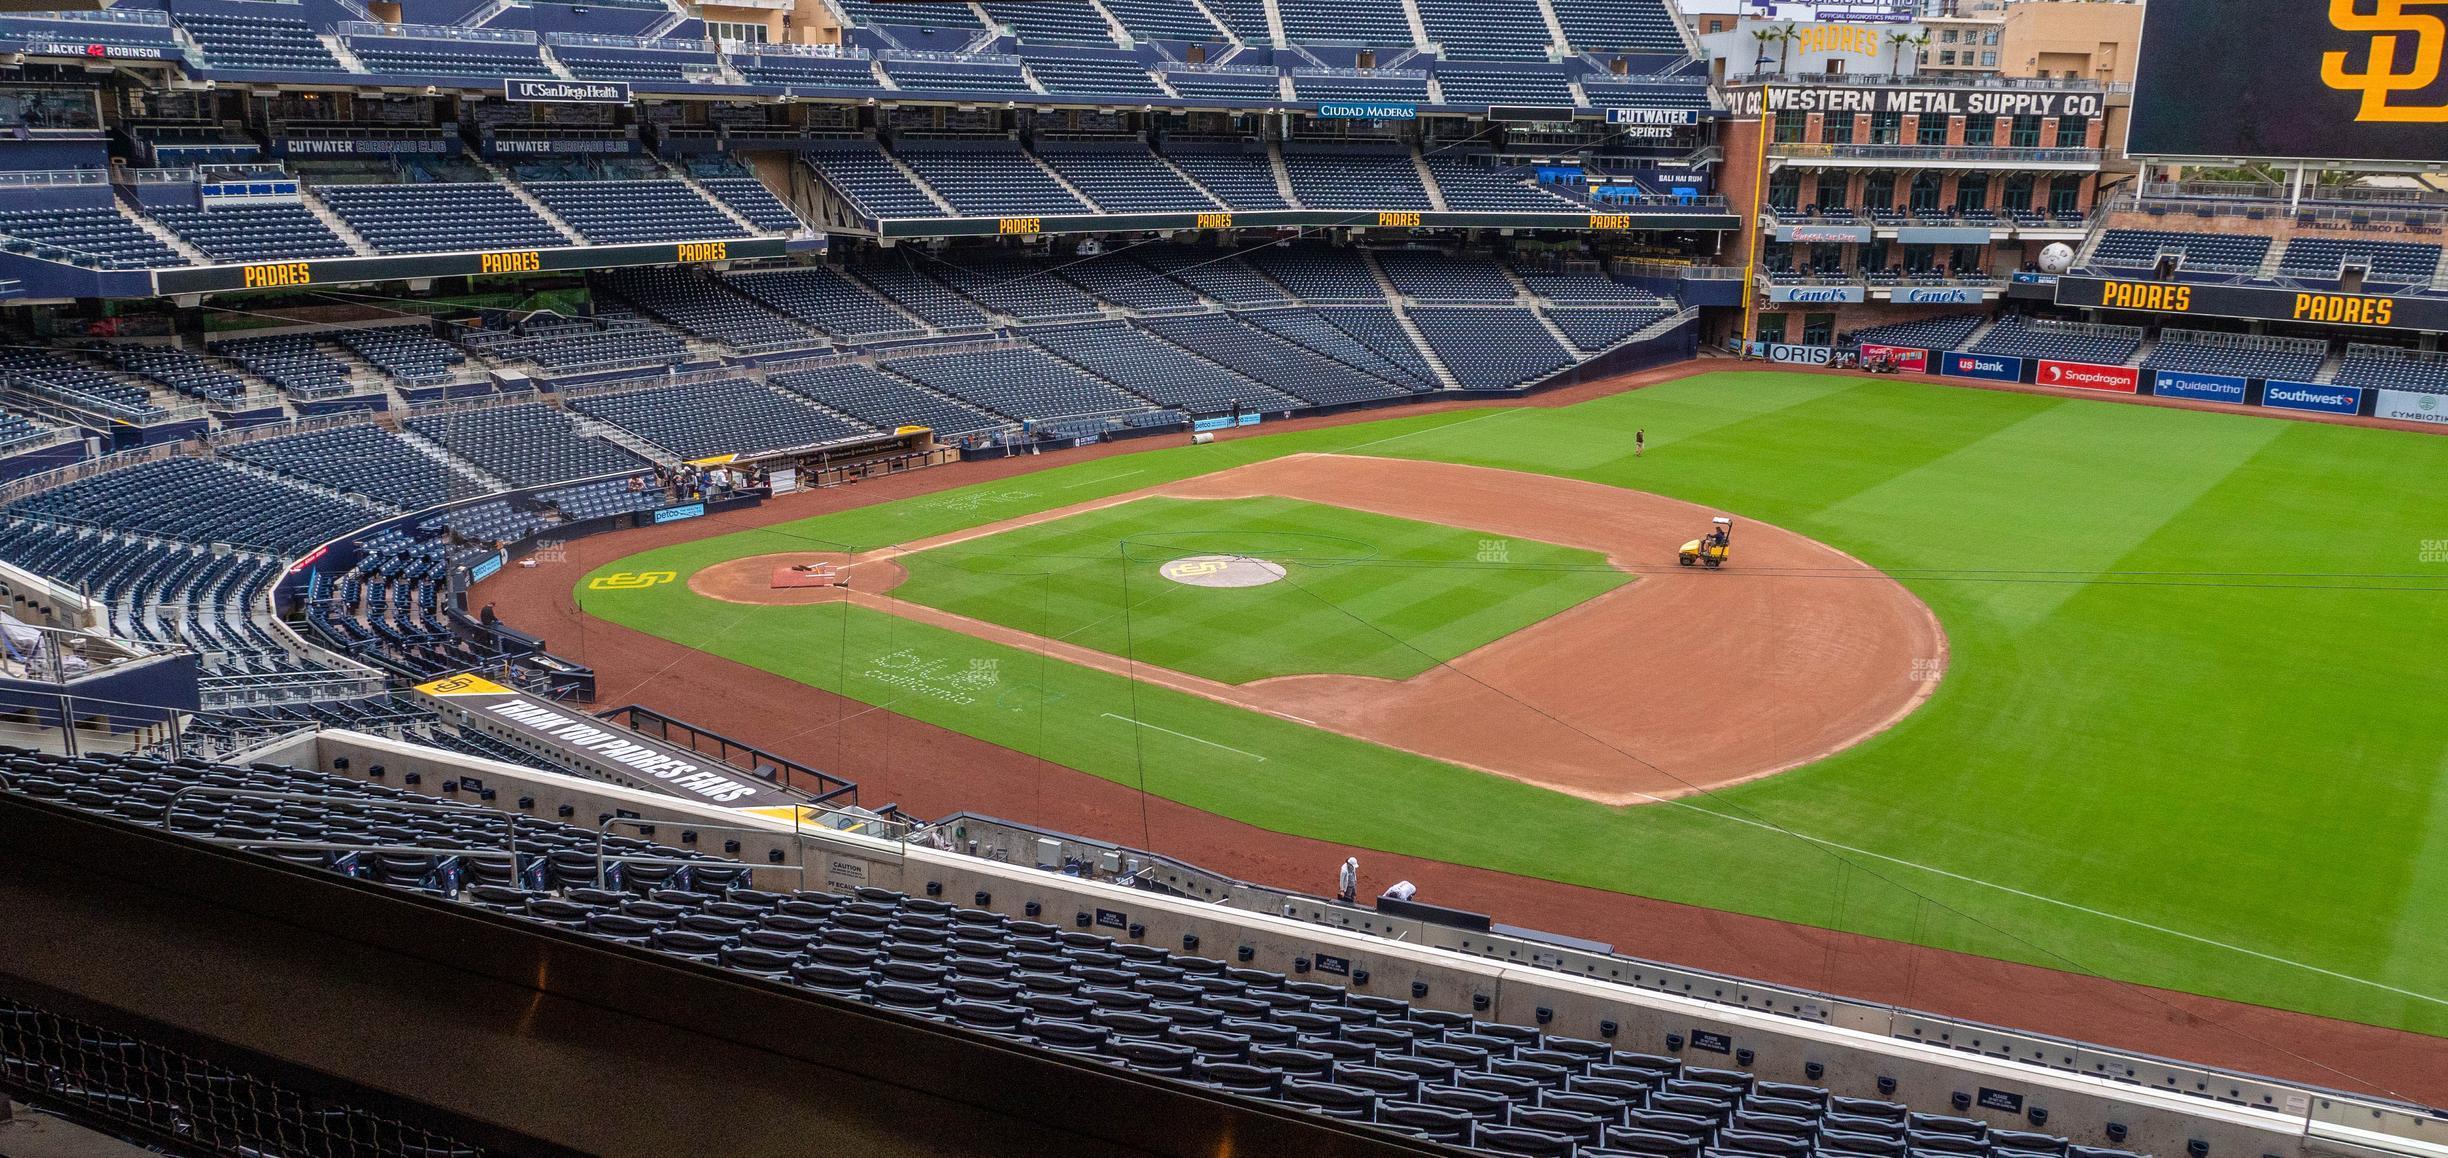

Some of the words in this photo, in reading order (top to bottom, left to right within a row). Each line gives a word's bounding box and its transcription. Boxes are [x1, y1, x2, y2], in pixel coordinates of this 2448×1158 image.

[1820, 12, 1845, 20] OFFICIAL
[1846, 13, 1884, 21] DIAGNOSTICS
[1799, 25, 1878, 57] PADRES
[46, 44, 85, 55] JACKIE
[87, 44, 105, 57] 42
[107, 46, 161, 58] ROBINSON
[520, 83, 538, 96] UC
[538, 83, 558, 97] San
[558, 85, 587, 100] Diego
[587, 85, 619, 98] Health
[1767, 88, 1875, 111] WESTERN
[1886, 91, 1960, 113] METAL
[1968, 92, 2057, 115] SUPPLY
[2064, 95, 2101, 116] CO.
[1321, 105, 1364, 116] CIUDAD
[1366, 106, 1415, 118] MADERAS
[1617, 109, 1688, 124] CUTWATER
[1629, 126, 1673, 138] SPIRITS
[288, 140, 353, 152] CUTWATER
[356, 140, 418, 153] CORONADO
[418, 140, 447, 153] CLUB
[496, 140, 550, 152] CUTWATER
[552, 140, 604, 153] CORONADO
[604, 140, 629, 153] CLUB
[1658, 174, 1675, 182] BALI
[1675, 175, 1687, 183] HAI
[1687, 175, 1703, 183] RUM
[1000, 218, 1040, 234] PADRES
[1197, 213, 1232, 229] PADRES
[1379, 212, 1421, 227] PADRES
[1590, 214, 1630, 229] PADRES
[2296, 221, 2347, 231] ESTRELLA
[2349, 223, 2392, 233] JALISCO
[2394, 225, 2443, 236] LANDING
[677, 242, 726, 262] PADRES
[482, 251, 540, 273] PADRES
[244, 262, 310, 288] PADRES
[1789, 287, 1847, 302] Canel's
[1908, 288, 1967, 303] Canel's
[2103, 281, 2192, 311] PADRES
[2294, 294, 2393, 326] PADRES
[1772, 345, 1828, 364] ORIS
[1960, 359, 1973, 370] us
[1974, 359, 2004, 372] bank
[2065, 370, 2131, 386] Snapdragon
[2176, 380, 2241, 394] QuidelOrtho
[2269, 388, 2343, 405] Southwest
[656, 510, 679, 521] petco
[485, 699, 577, 731] THANK
[548, 723, 617, 746] YOU
[587, 739, 698, 779] PADRES
[669, 771, 757, 802] FANS
[833, 861, 862, 873] CAUTION
